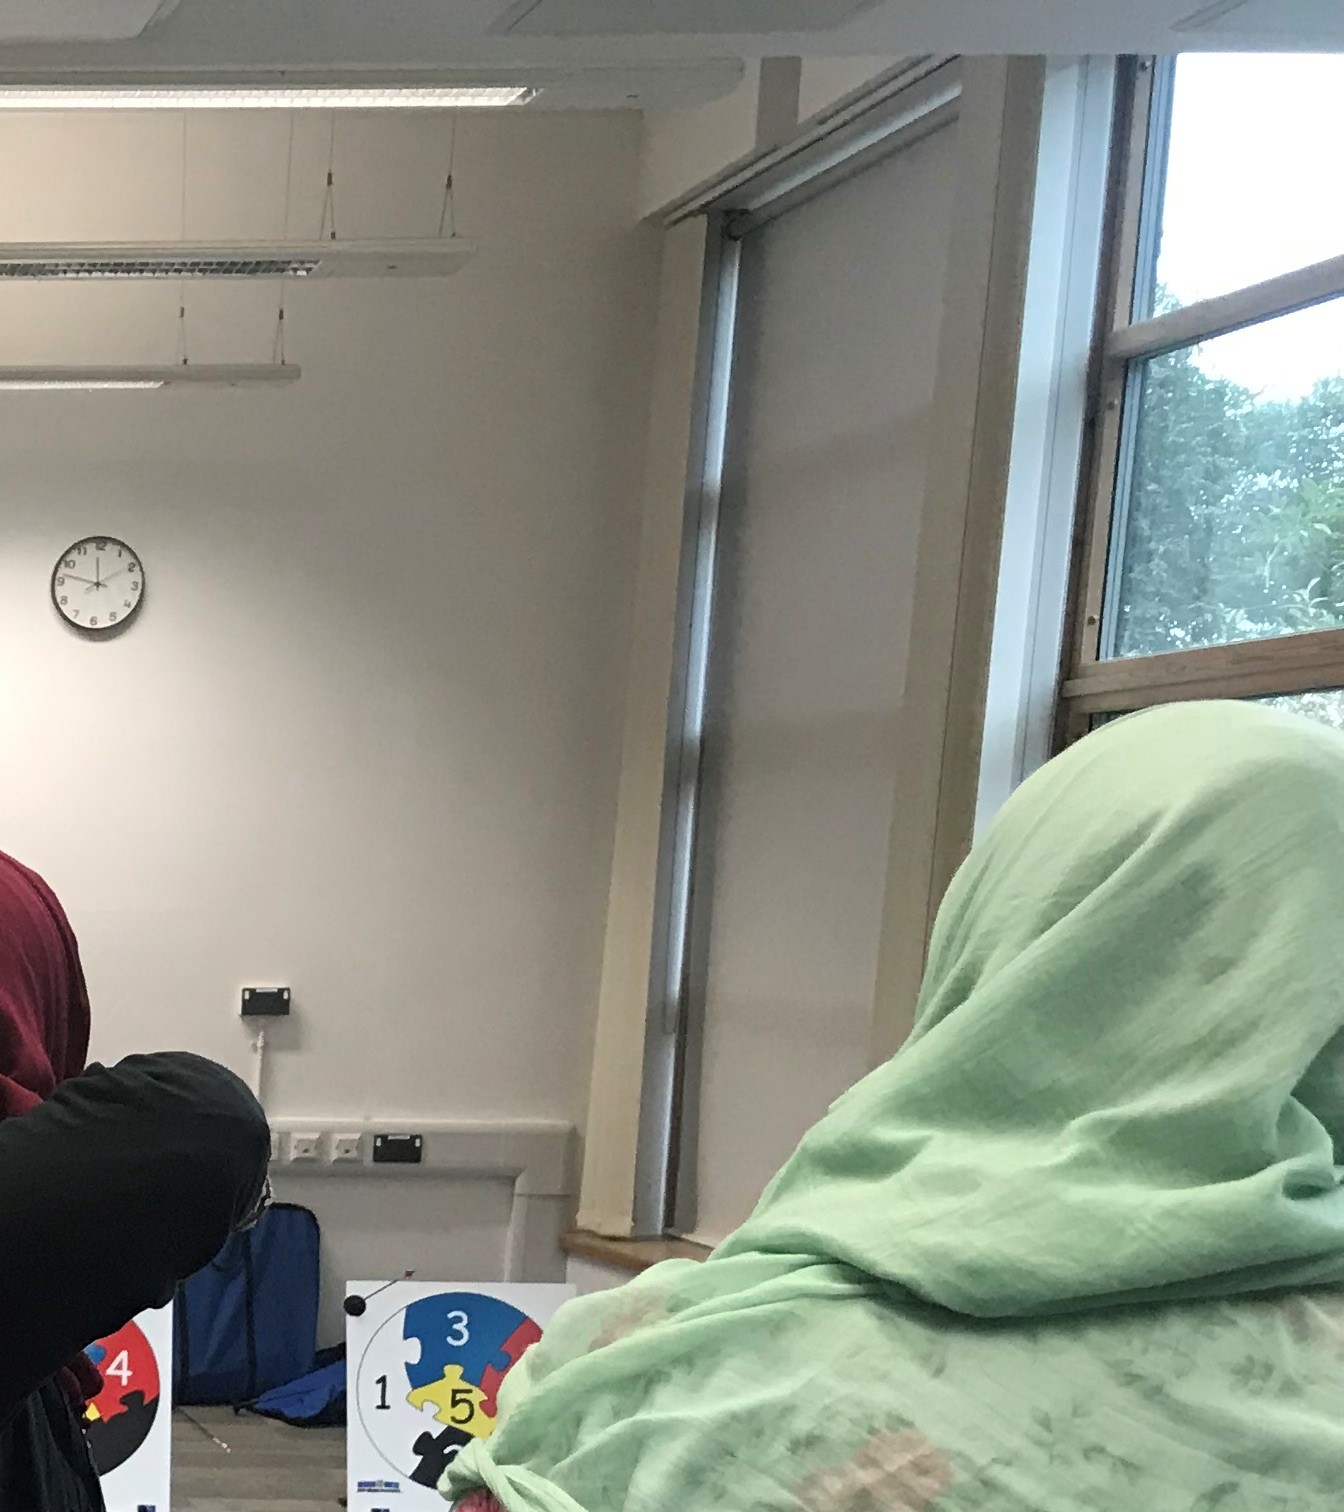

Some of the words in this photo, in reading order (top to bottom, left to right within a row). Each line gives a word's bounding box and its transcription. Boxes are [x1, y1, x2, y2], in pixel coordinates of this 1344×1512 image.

[128, 562, 136, 573] 2
[57, 577, 65, 587] 9
[131, 580, 139, 592] 3
[60, 595, 68, 605] 8
[73, 609, 80, 619] 7
[109, 611, 117, 622] 5
[90, 616, 98, 626] 6
[446, 1311, 469, 1347] 3
[106, 1350, 133, 1386] 4
[375, 1374, 390, 1410] 1
[450, 1388, 475, 1424] 5
